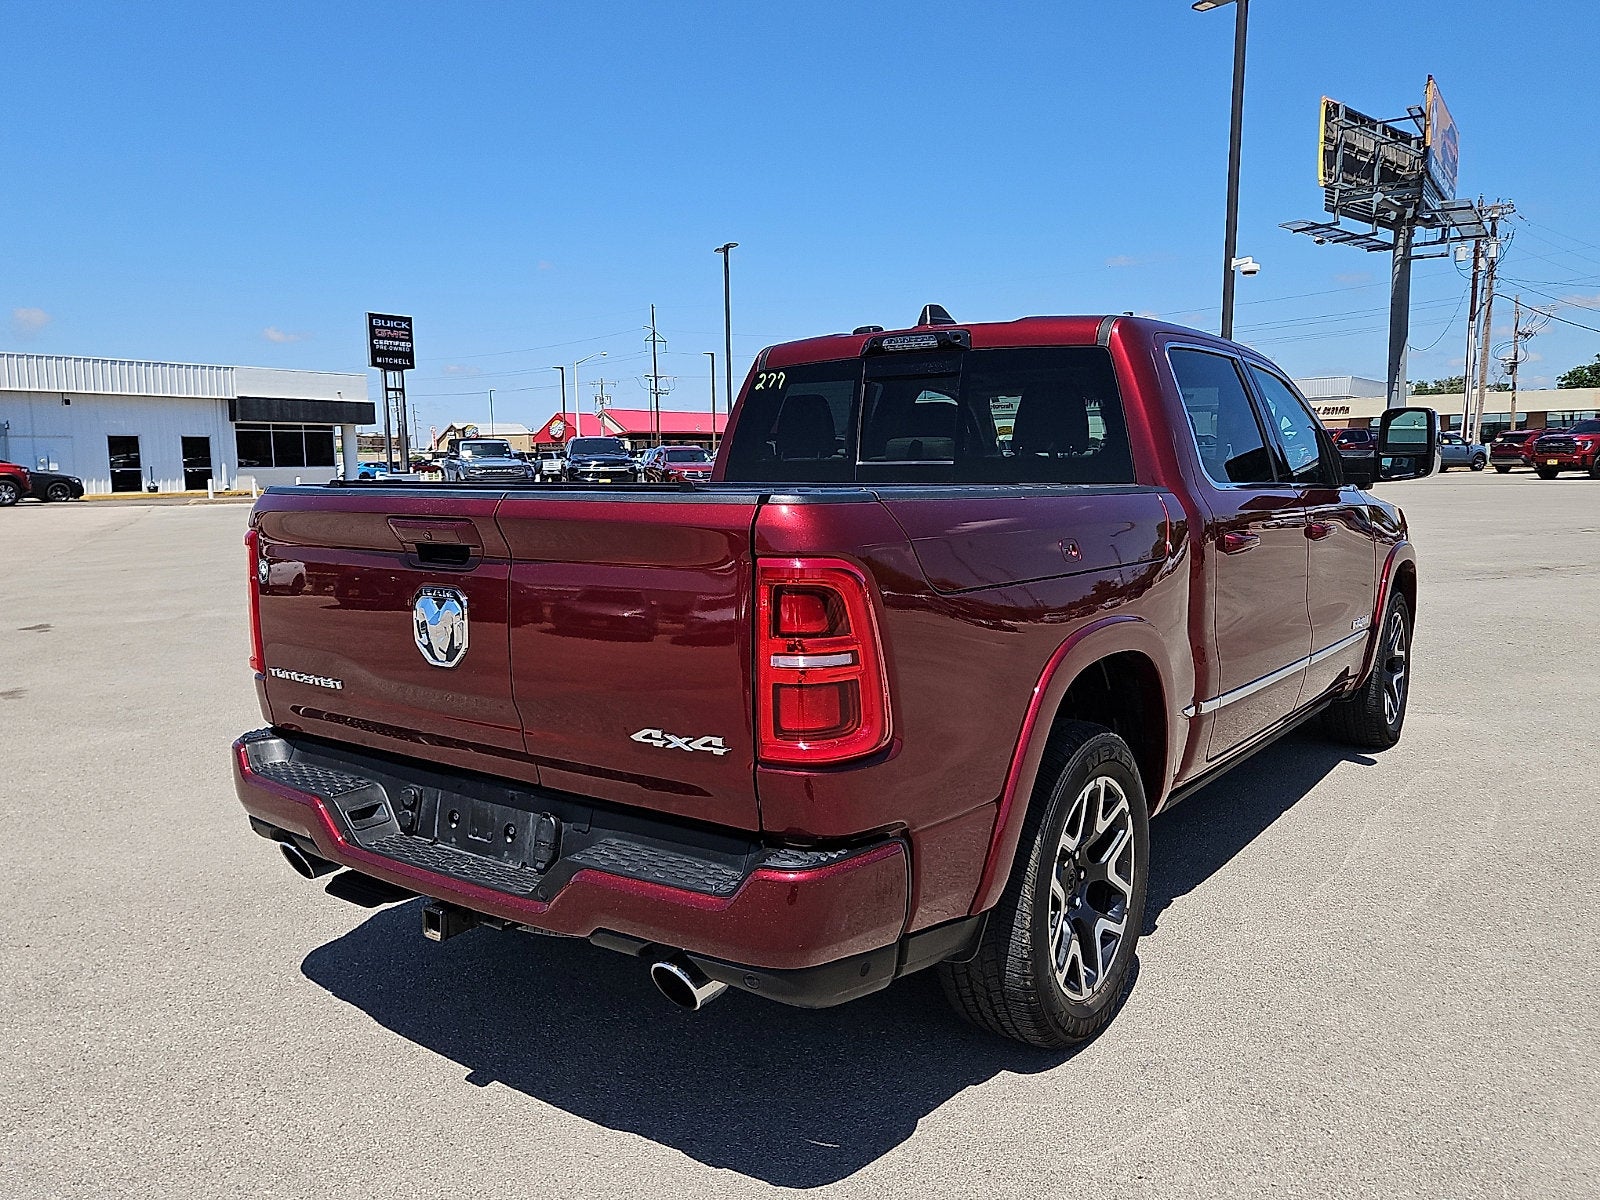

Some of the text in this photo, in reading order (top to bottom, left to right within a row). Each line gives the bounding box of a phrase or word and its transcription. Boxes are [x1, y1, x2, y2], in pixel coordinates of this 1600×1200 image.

[372, 318, 410, 329] BUICK
[374, 328, 410, 339] GMC
[373, 339, 412, 348] CERTIFIED
[375, 345, 411, 353] PRE-OWNED
[376, 357, 411, 365] MITCHELL
[755, 371, 786, 390] 277
[268, 666, 343, 690] TUNGSTEN
